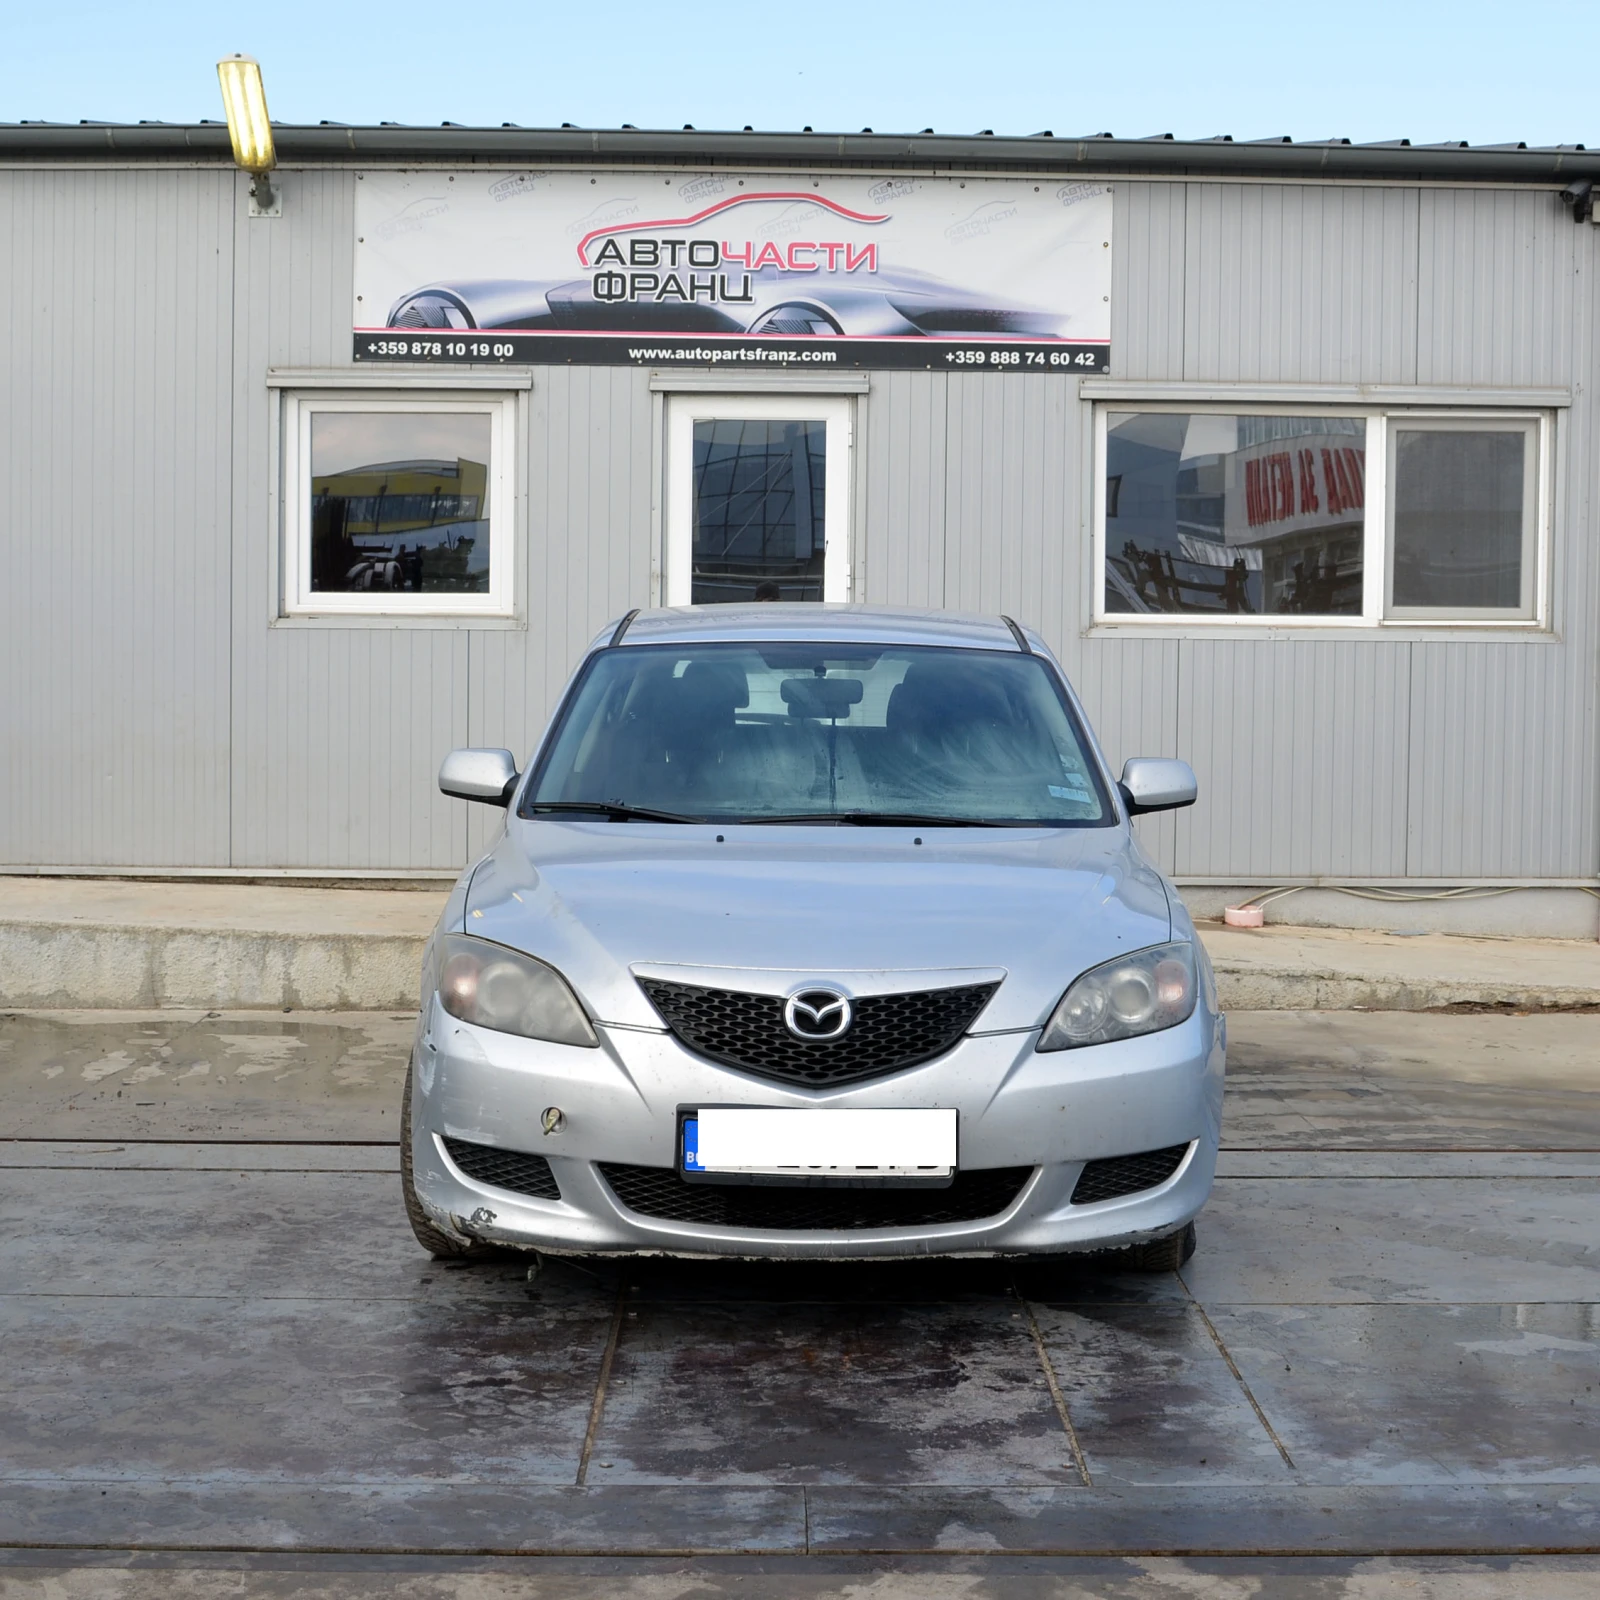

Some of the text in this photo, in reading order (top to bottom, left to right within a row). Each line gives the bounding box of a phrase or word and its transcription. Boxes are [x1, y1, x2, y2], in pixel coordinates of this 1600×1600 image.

[593, 239, 876, 271] АВТОЧАСТИ
[593, 270, 753, 302] ФРАНЦ
[368, 341, 514, 357] +359 878 10 19 00
[628, 347, 837, 362] www.autopartsfranz.com
[945, 351, 1095, 366] +359 888 74 60 42
